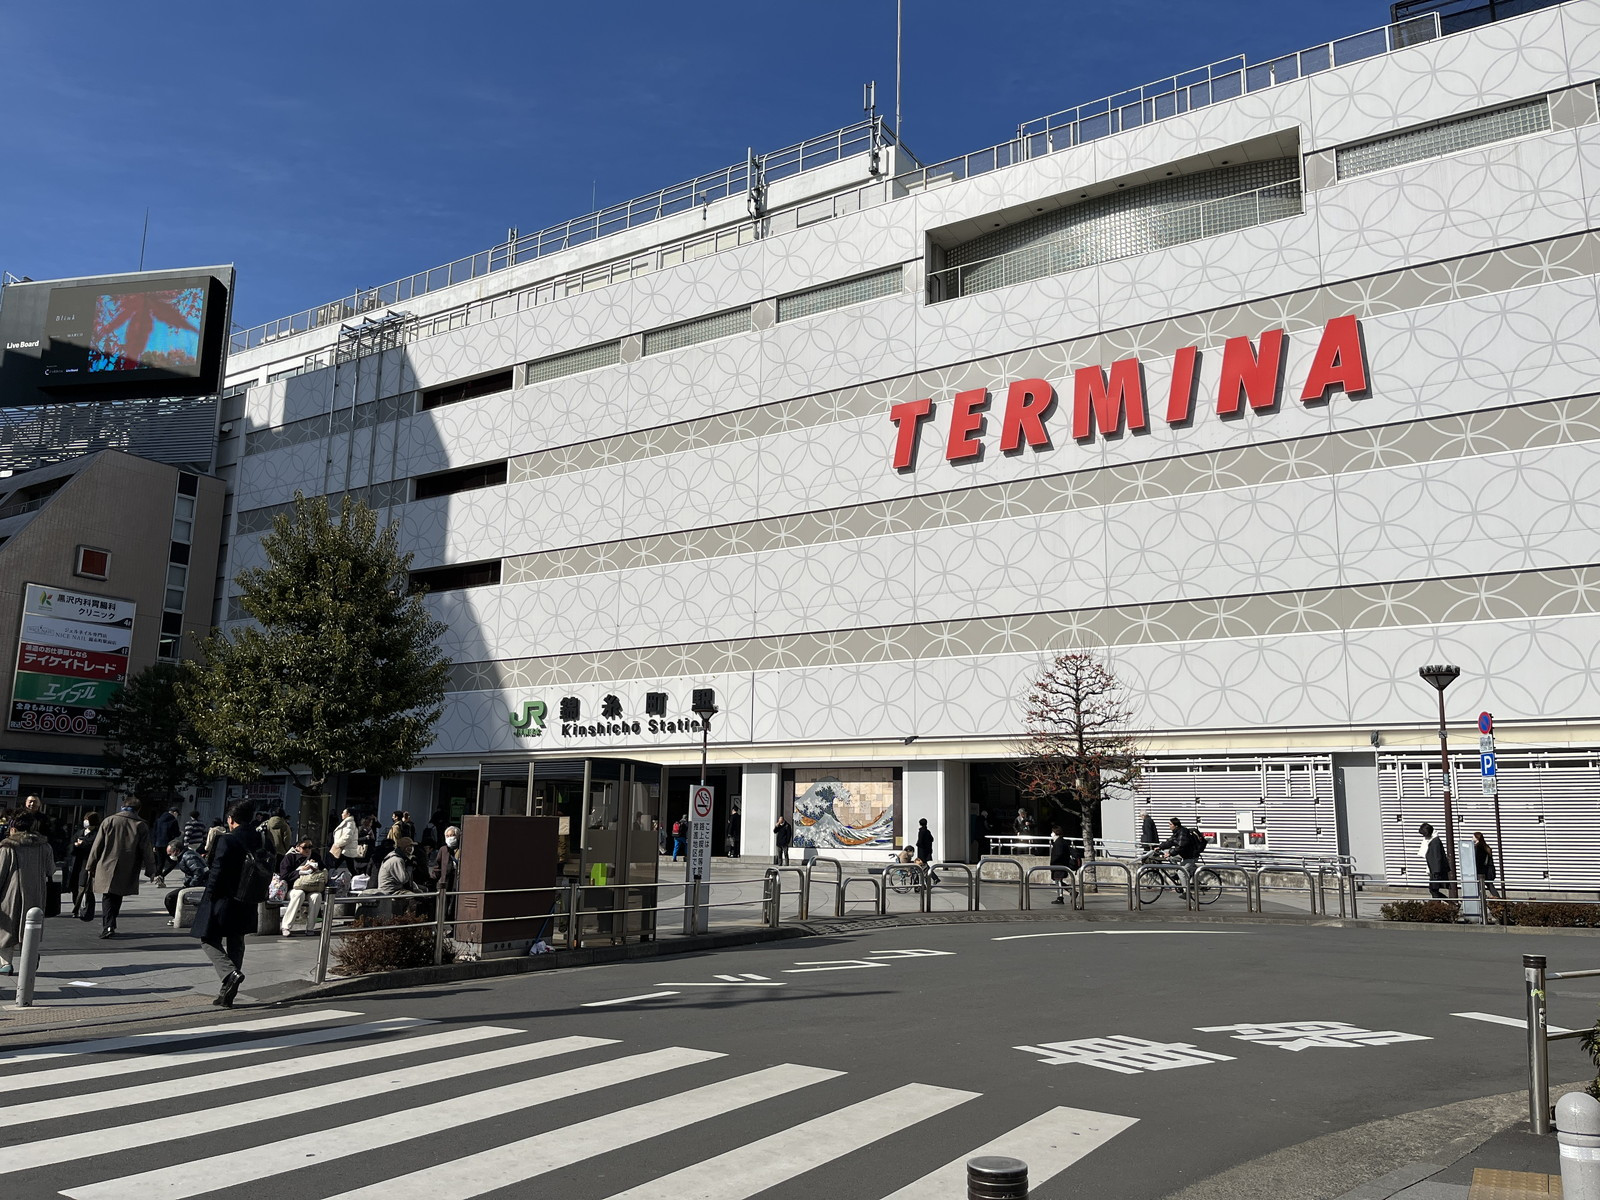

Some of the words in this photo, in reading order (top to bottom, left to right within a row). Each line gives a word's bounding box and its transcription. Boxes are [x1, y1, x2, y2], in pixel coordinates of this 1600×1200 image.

[6, 342, 20, 350] Live
[20, 340, 40, 348] Board
[890, 314, 1372, 473] TERMINA
[78, 608, 116, 620] クリニック
[24, 652, 117, 674] テイケイトレード
[36, 681, 100, 703] エイブル
[16, 702, 68, 714] 全身もみほぐし
[509, 701, 548, 729] JR
[1484, 755, 1492, 774] P
